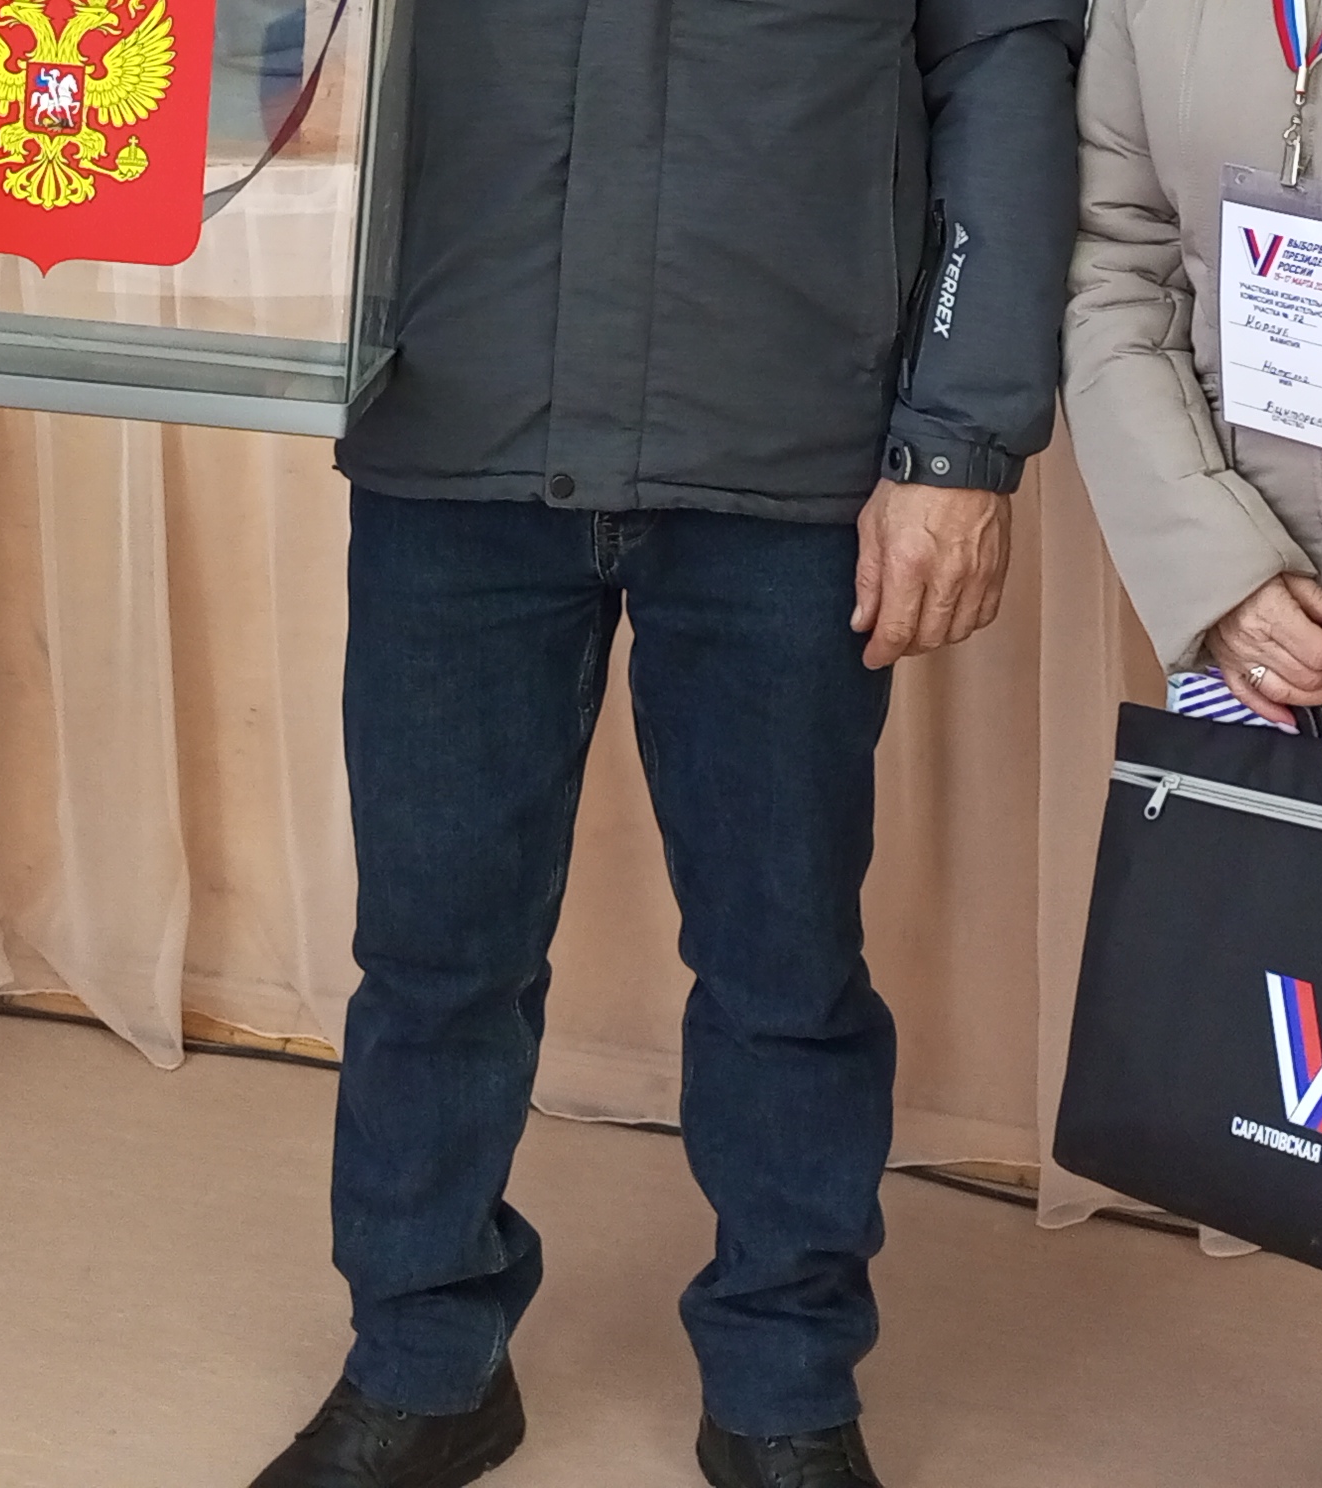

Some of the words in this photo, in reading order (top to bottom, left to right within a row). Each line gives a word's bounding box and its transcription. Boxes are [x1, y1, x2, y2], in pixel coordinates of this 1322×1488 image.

[1277, 261, 1315, 277] РОССИИ
[933, 252, 966, 339] TERREX
[1231, 1116, 1322, 1163] САРАТОВСКАЯ
